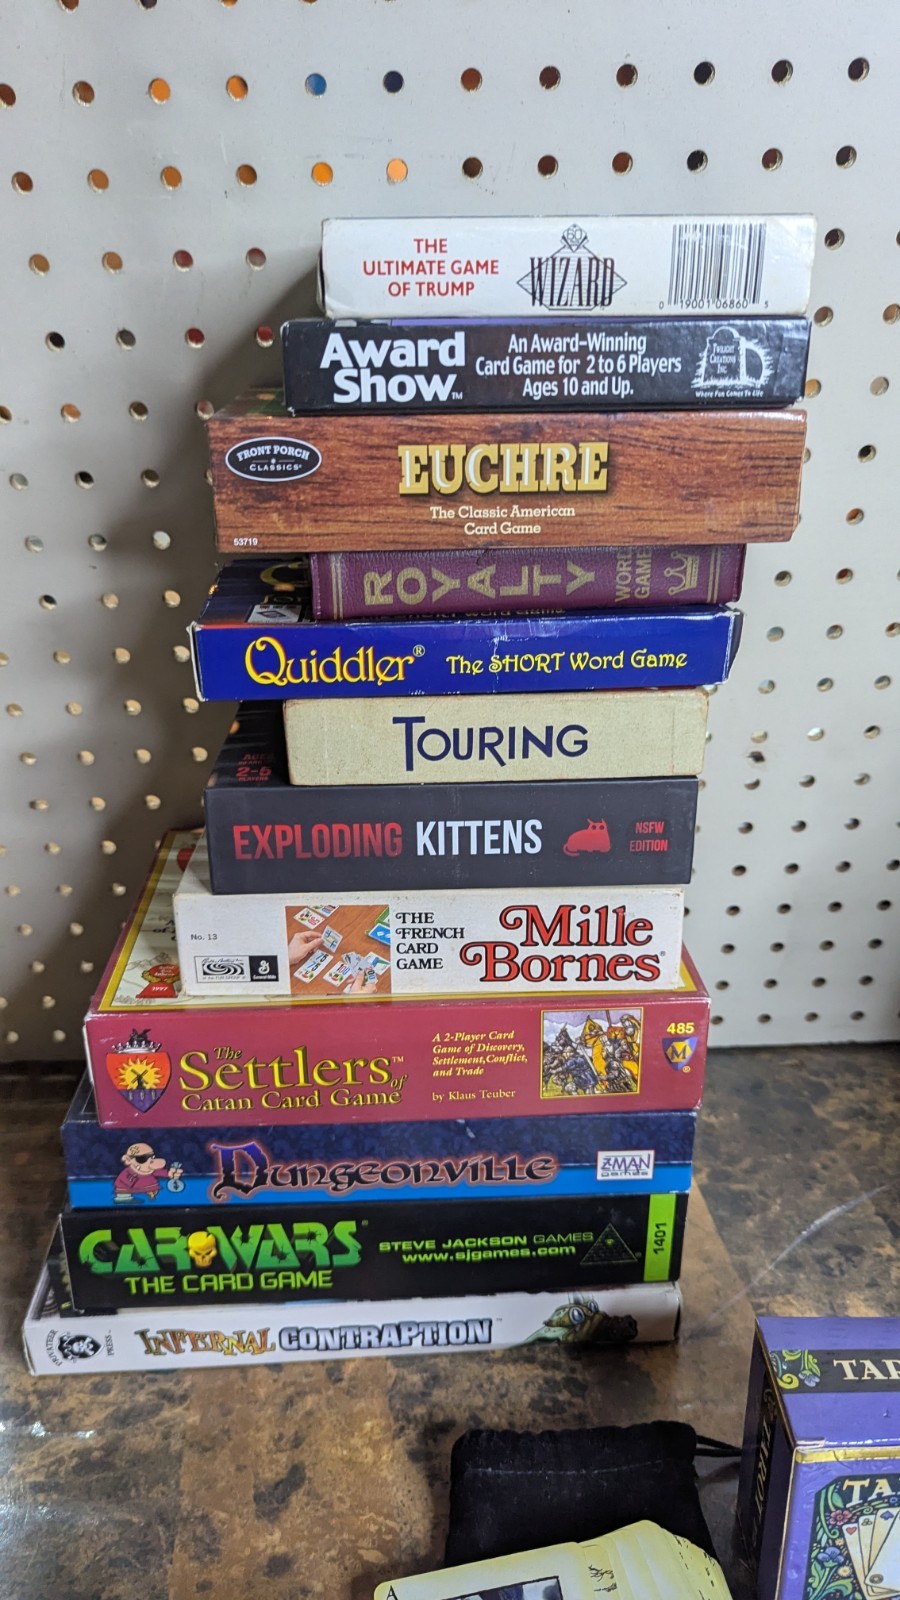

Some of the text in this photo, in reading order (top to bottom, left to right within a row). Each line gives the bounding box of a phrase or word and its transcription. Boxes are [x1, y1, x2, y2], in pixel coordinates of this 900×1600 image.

[413, 238, 447, 254] THE
[363, 259, 499, 276] ULTIMATE GAME
[388, 281, 475, 297] OF TRUMP
[529, 256, 615, 307] WIZARD
[659, 301, 664, 309] 0
[320, 331, 465, 369] Award
[508, 331, 647, 355] An Award-Winning
[475, 352, 682, 376] Card Game for 2 to 6 Players
[522, 377, 634, 399] Ages 10 and Up.
[236, 445, 310, 462] FRONT PORCH
[398, 442, 608, 494] EUCHRE
[430, 504, 575, 519] The Classic American
[464, 522, 541, 536] Card Game
[233, 537, 258, 546] 53719
[364, 561, 596, 606] ROYALTY
[446, 648, 688, 675] The SHORT Word Game
[392, 716, 588, 771] TOURING
[635, 821, 665, 834] NSFW
[233, 819, 543, 860] EXPLODING KITTENS
[629, 839, 669, 852] EDITION
[395, 912, 435, 924] THE
[500, 904, 653, 947] Mille
[395, 927, 465, 940] FRENCH
[396, 942, 438, 954] CARD
[396, 958, 443, 970] GAME
[433, 1030, 514, 1043] A 2-Player Card
[667, 1023, 694, 1034] 485
[214, 1046, 242, 1060] The
[433, 1042, 525, 1054] Game of Discovery,
[671, 1045, 687, 1060] M
[433, 1055, 485, 1065] Settlement,
[433, 1066, 484, 1077] and Trade
[391, 1075, 407, 1090] of
[181, 1088, 401, 1112] Catan Card Game
[432, 1089, 516, 1102] by Klaus Teuber
[79, 1220, 362, 1273] CAR WARS
[379, 1232, 593, 1251] STEVE JACKSON GAMES
[653, 1222, 667, 1255] 1401
[402, 1245, 576, 1263] www.sjgames.com
[124, 1269, 333, 1295] THE CARD GAME
[279, 1318, 493, 1351] CONTRAPTION
[843, 1478, 900, 1508] TA
